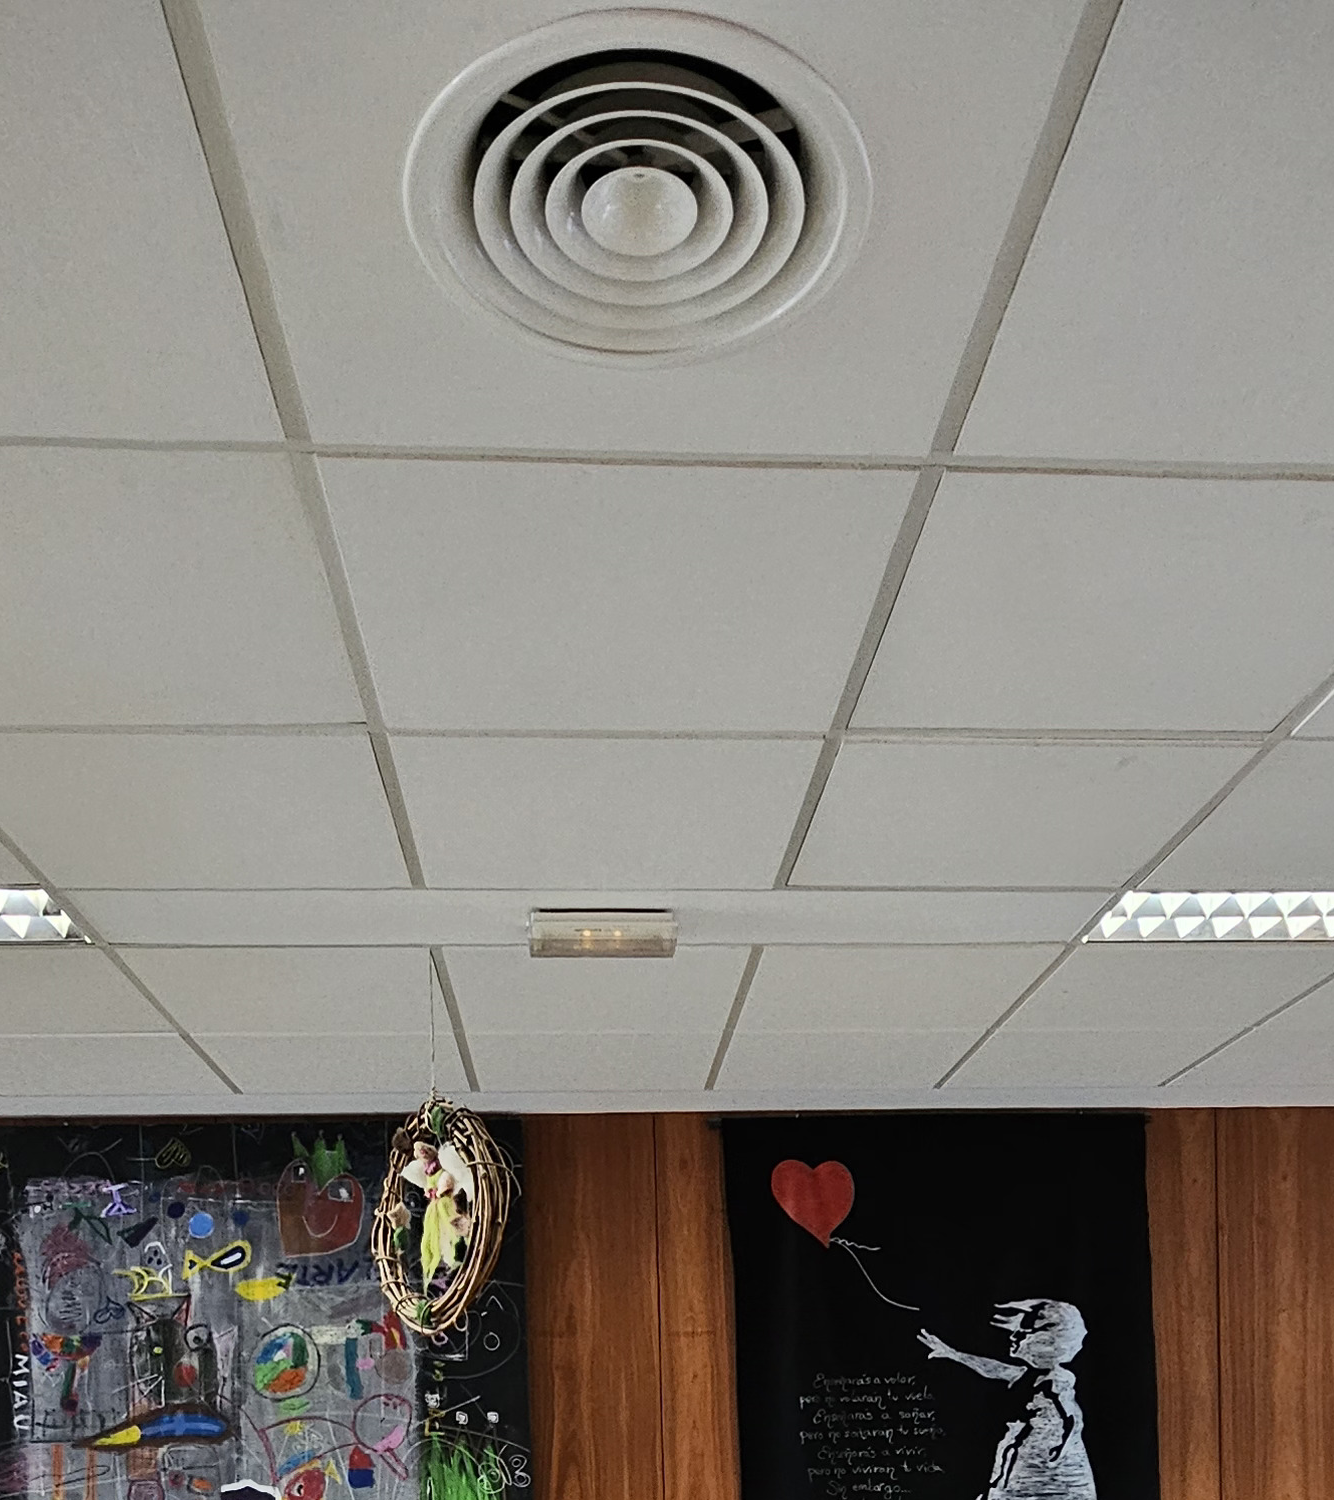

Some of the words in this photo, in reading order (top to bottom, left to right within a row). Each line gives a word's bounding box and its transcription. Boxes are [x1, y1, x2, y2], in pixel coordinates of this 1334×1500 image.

[873, 1376, 881, 1386] a
[12, 1354, 31, 1431] MIAU
[881, 1411, 891, 1420] a
